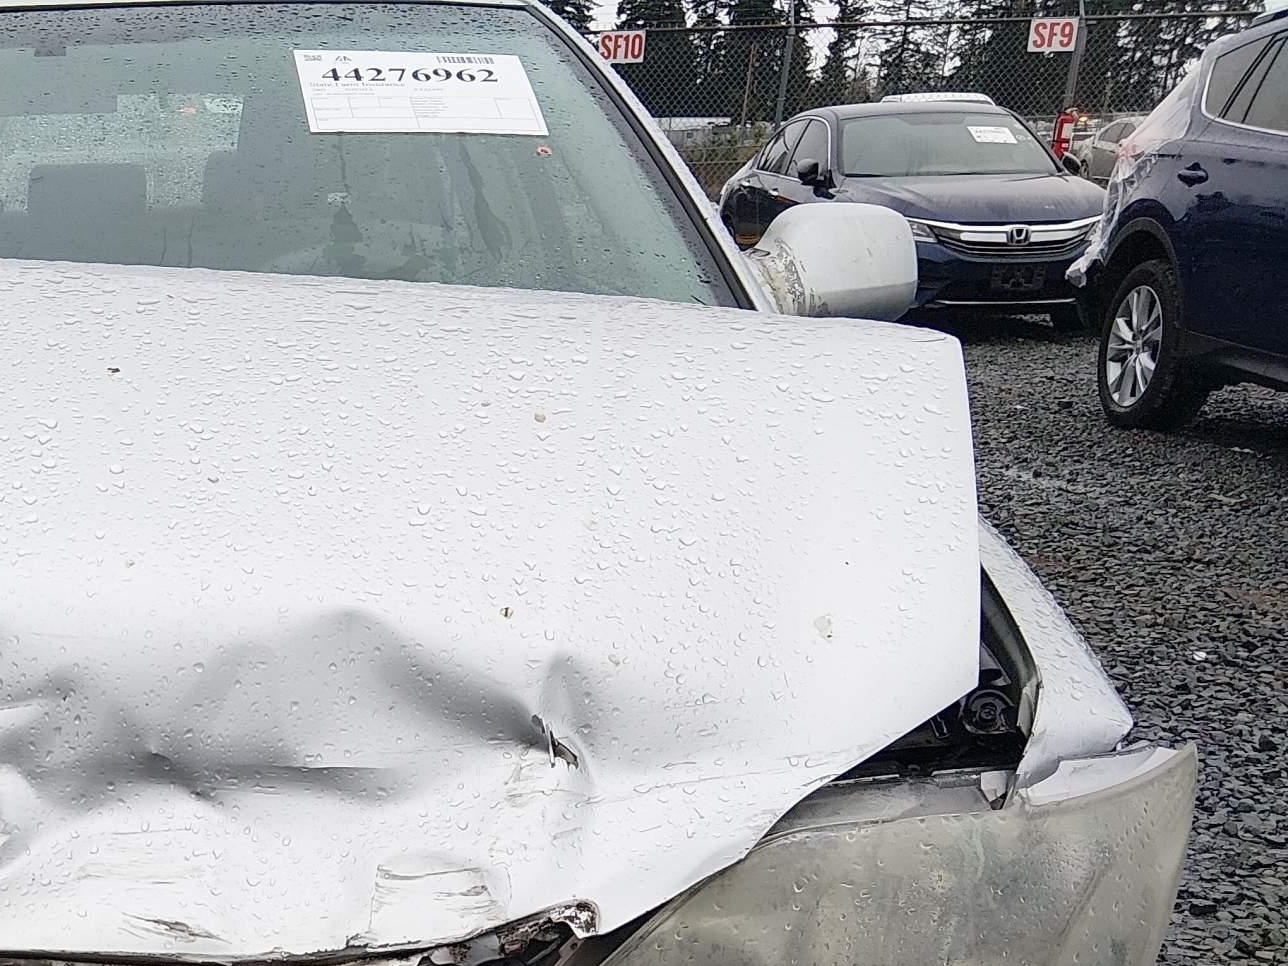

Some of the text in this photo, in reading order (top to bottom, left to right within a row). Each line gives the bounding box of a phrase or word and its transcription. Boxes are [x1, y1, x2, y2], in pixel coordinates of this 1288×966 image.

[600, 33, 643, 60] SF10
[1032, 21, 1074, 48] SF9
[321, 66, 499, 83] 44276962
